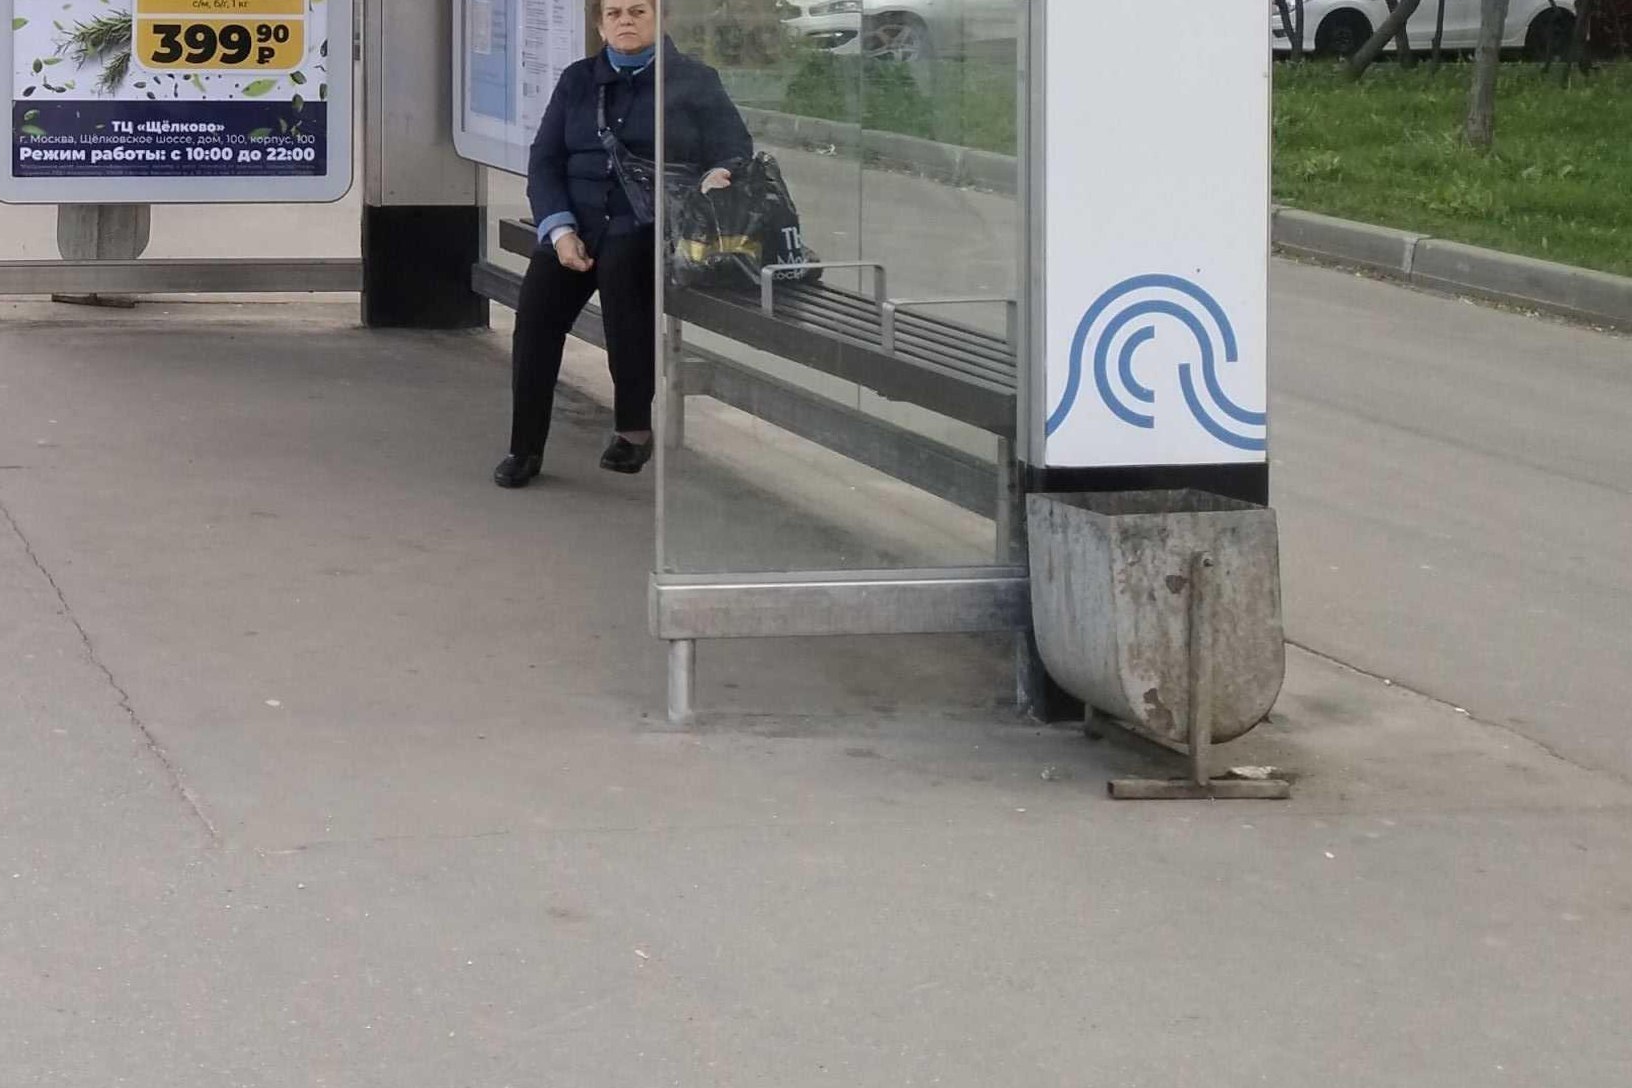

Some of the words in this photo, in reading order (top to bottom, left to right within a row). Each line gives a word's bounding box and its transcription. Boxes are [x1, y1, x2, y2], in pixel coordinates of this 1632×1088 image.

[151, 23, 252, 64] 399
[256, 23, 290, 43] 90
[111, 120, 133, 134] ТЦ
[137, 119, 225, 134] «Щёлково»
[30, 134, 77, 145] Москва,
[80, 134, 153, 145] Щёлковское
[156, 136, 196, 145] шоссе,
[19, 146, 86, 161] Режим
[91, 146, 166, 164] работы:
[170, 149, 182, 161] с
[186, 147, 233, 161] 10:00
[237, 149, 262, 162] до
[266, 147, 315, 161] 22:00
